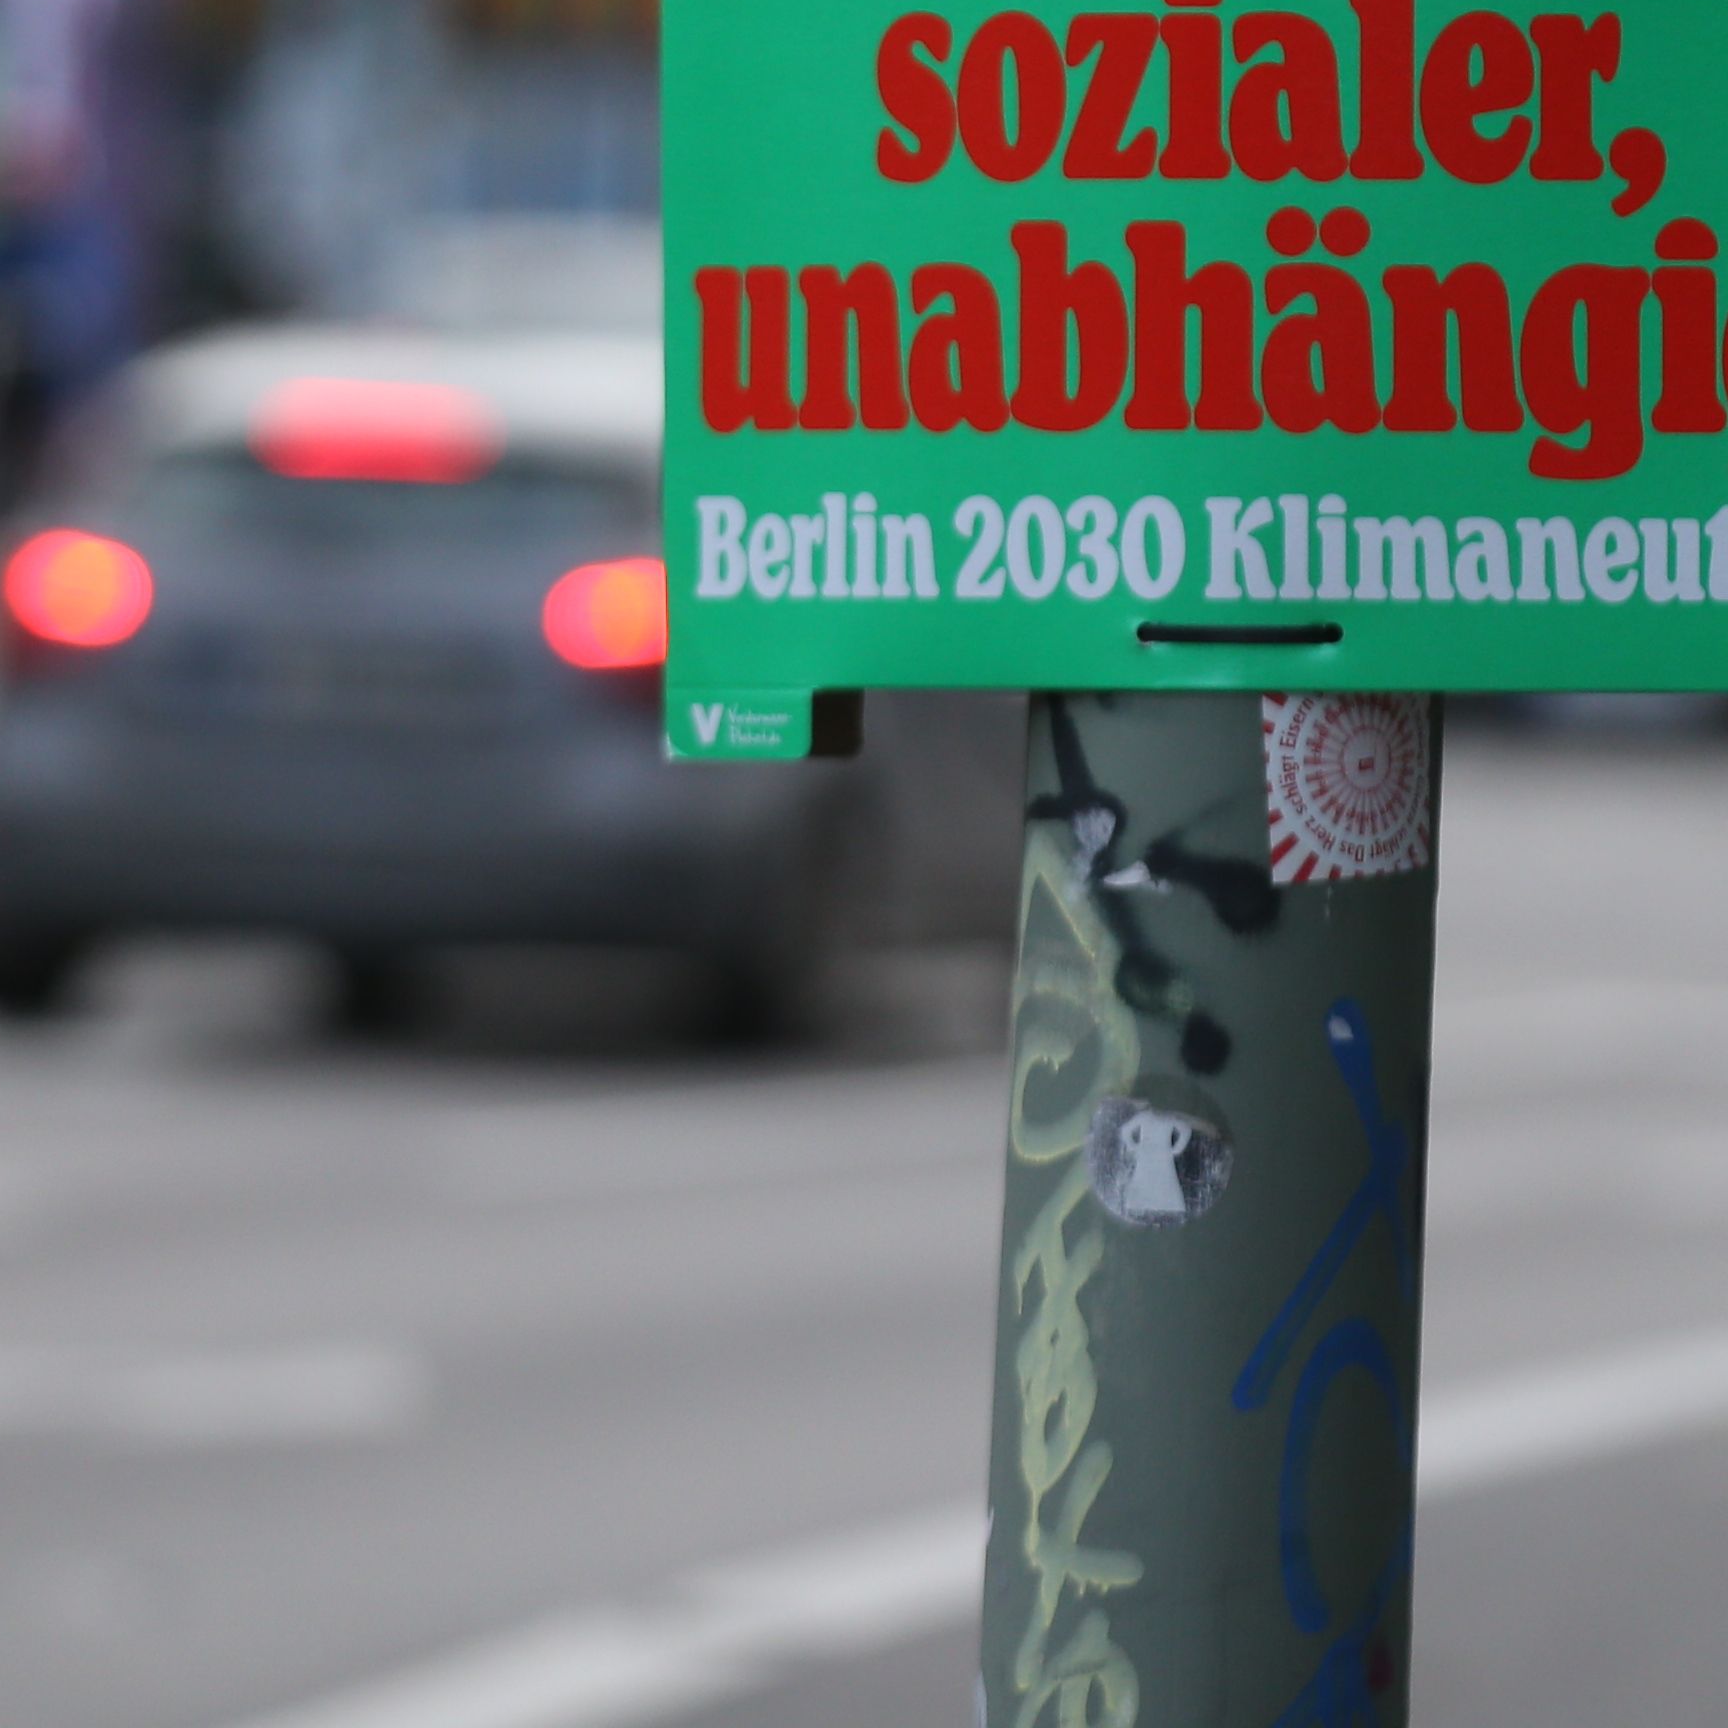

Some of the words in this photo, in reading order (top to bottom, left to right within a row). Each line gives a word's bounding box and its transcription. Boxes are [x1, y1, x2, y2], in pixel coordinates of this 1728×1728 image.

[695, 491, 941, 602] Berlin
[953, 494, 1187, 602] 2030
[1279, 697, 1314, 749] Eisern
[1279, 756, 1308, 815] schlägt
[1305, 816, 1337, 851] Herz
[1339, 842, 1365, 862] Das
